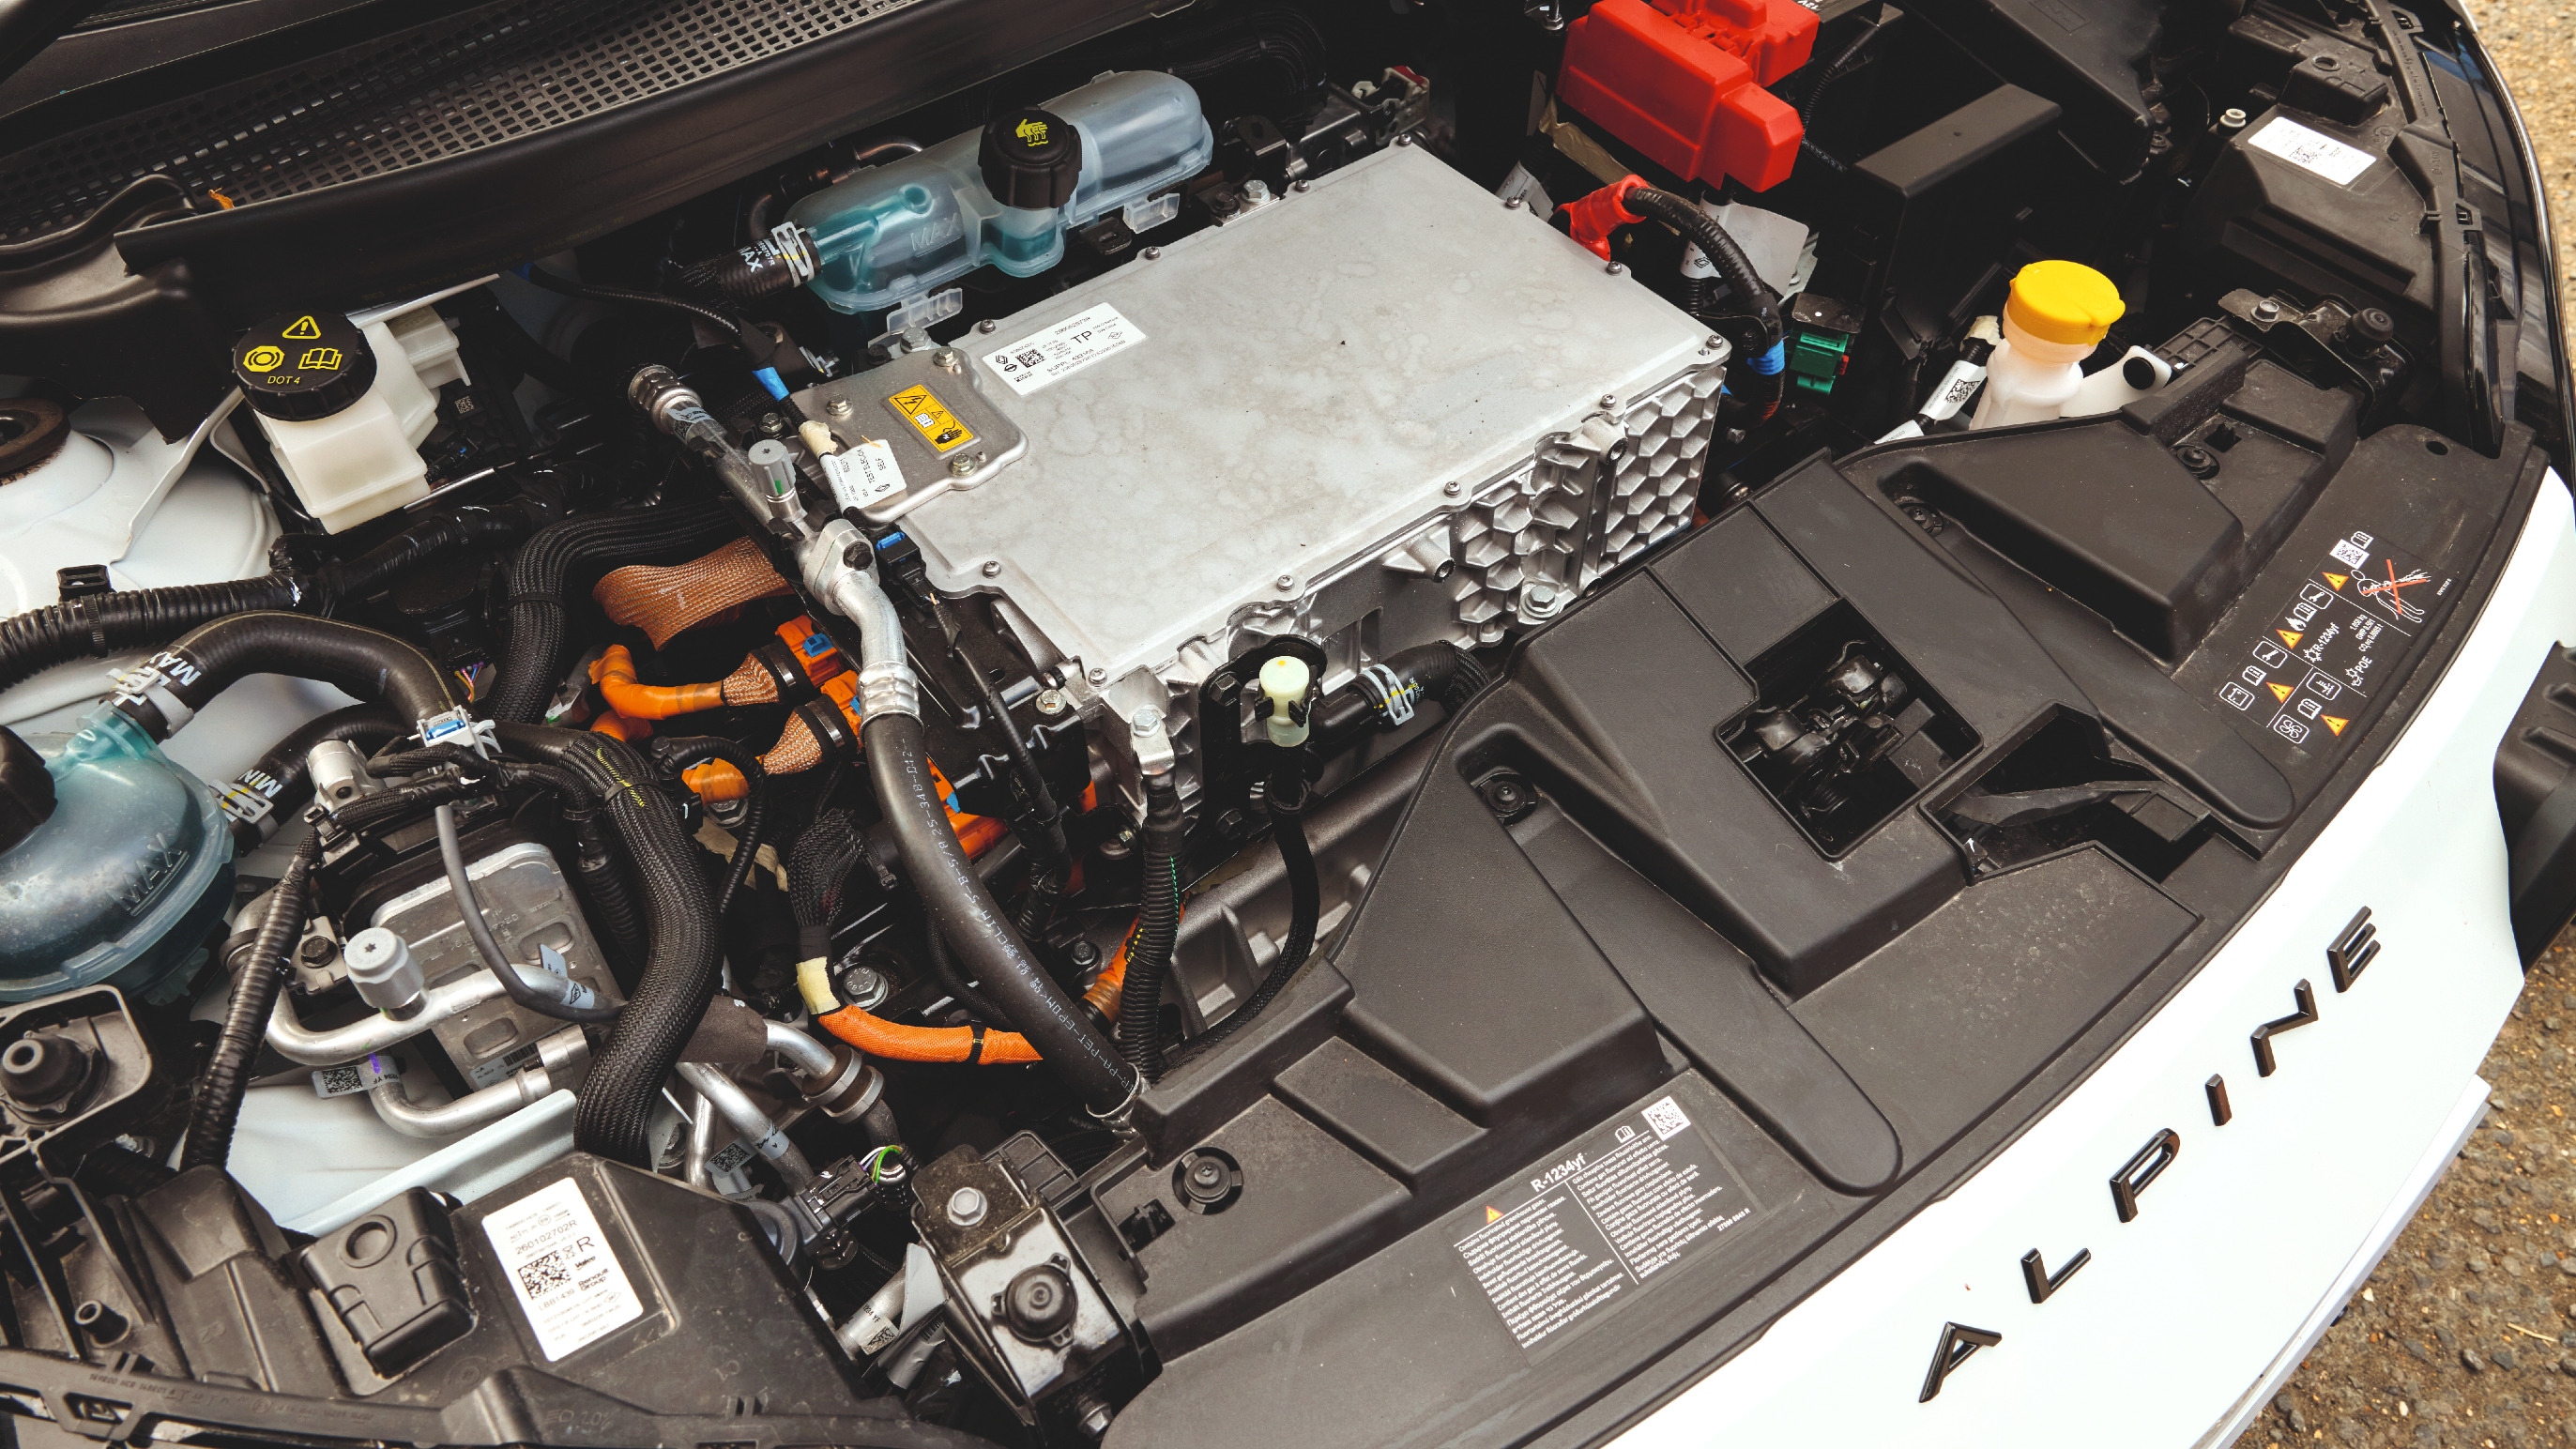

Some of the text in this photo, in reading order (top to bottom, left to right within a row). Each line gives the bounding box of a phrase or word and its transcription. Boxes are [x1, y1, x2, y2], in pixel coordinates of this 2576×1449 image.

[909, 211, 961, 251] MAX
[1069, 330, 1091, 343] TP
[267, 375, 301, 385] DOT 4
[2311, 621, 2339, 651] R-1234yf
[148, 651, 202, 687] MAX
[2354, 655, 2372, 673] POE
[238, 769, 283, 799] MIN
[106, 831, 182, 911] MAX
[1918, 905, 2382, 1403] ALPINE
[1531, 1152, 1586, 1193] R-1234yf
[514, 1219, 577, 1255] 260102702R
[575, 1235, 595, 1252] R
[574, 1255, 596, 1270] Valeo
[577, 1267, 609, 1288] Renault
[580, 1275, 606, 1290] Group
